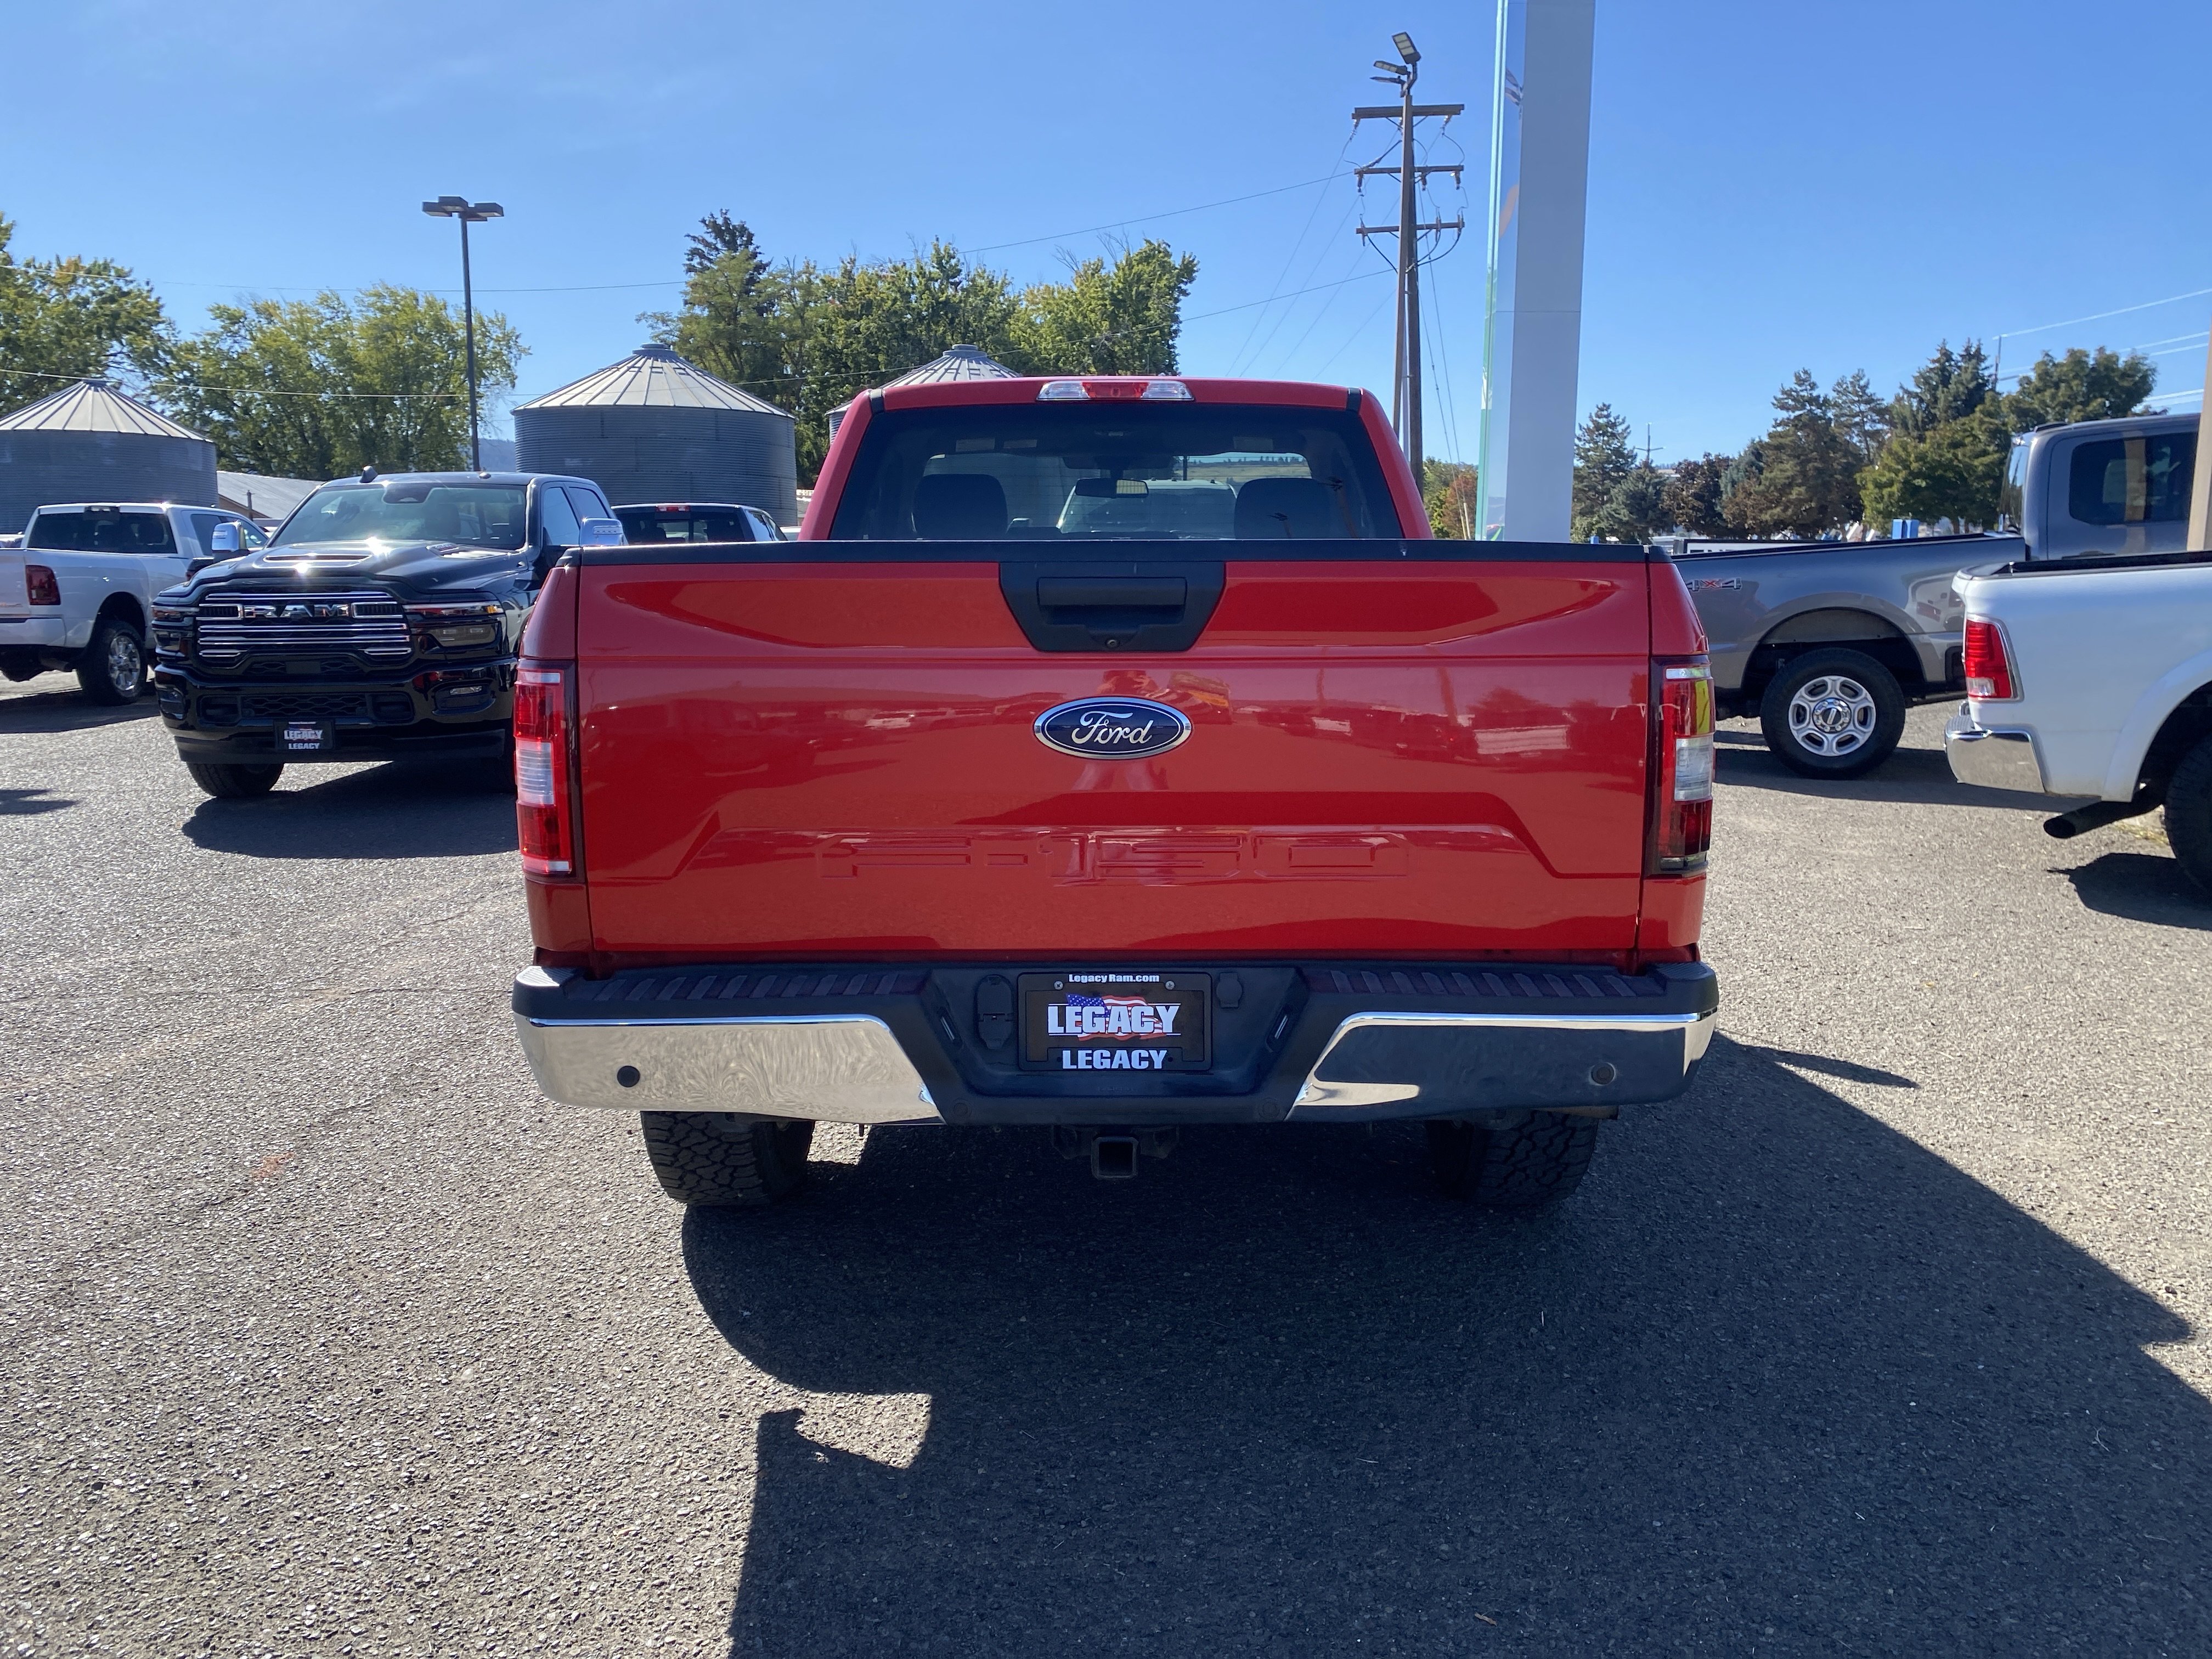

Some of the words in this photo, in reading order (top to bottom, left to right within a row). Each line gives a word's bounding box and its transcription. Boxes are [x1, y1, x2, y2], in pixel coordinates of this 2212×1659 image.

[245, 604, 350, 618] RAM
[284, 730, 323, 740] LEGACY
[1071, 710, 1154, 744] Ford
[1048, 1006, 1180, 1033] LEGACY
[1063, 1050, 1167, 1069] LEGACY
